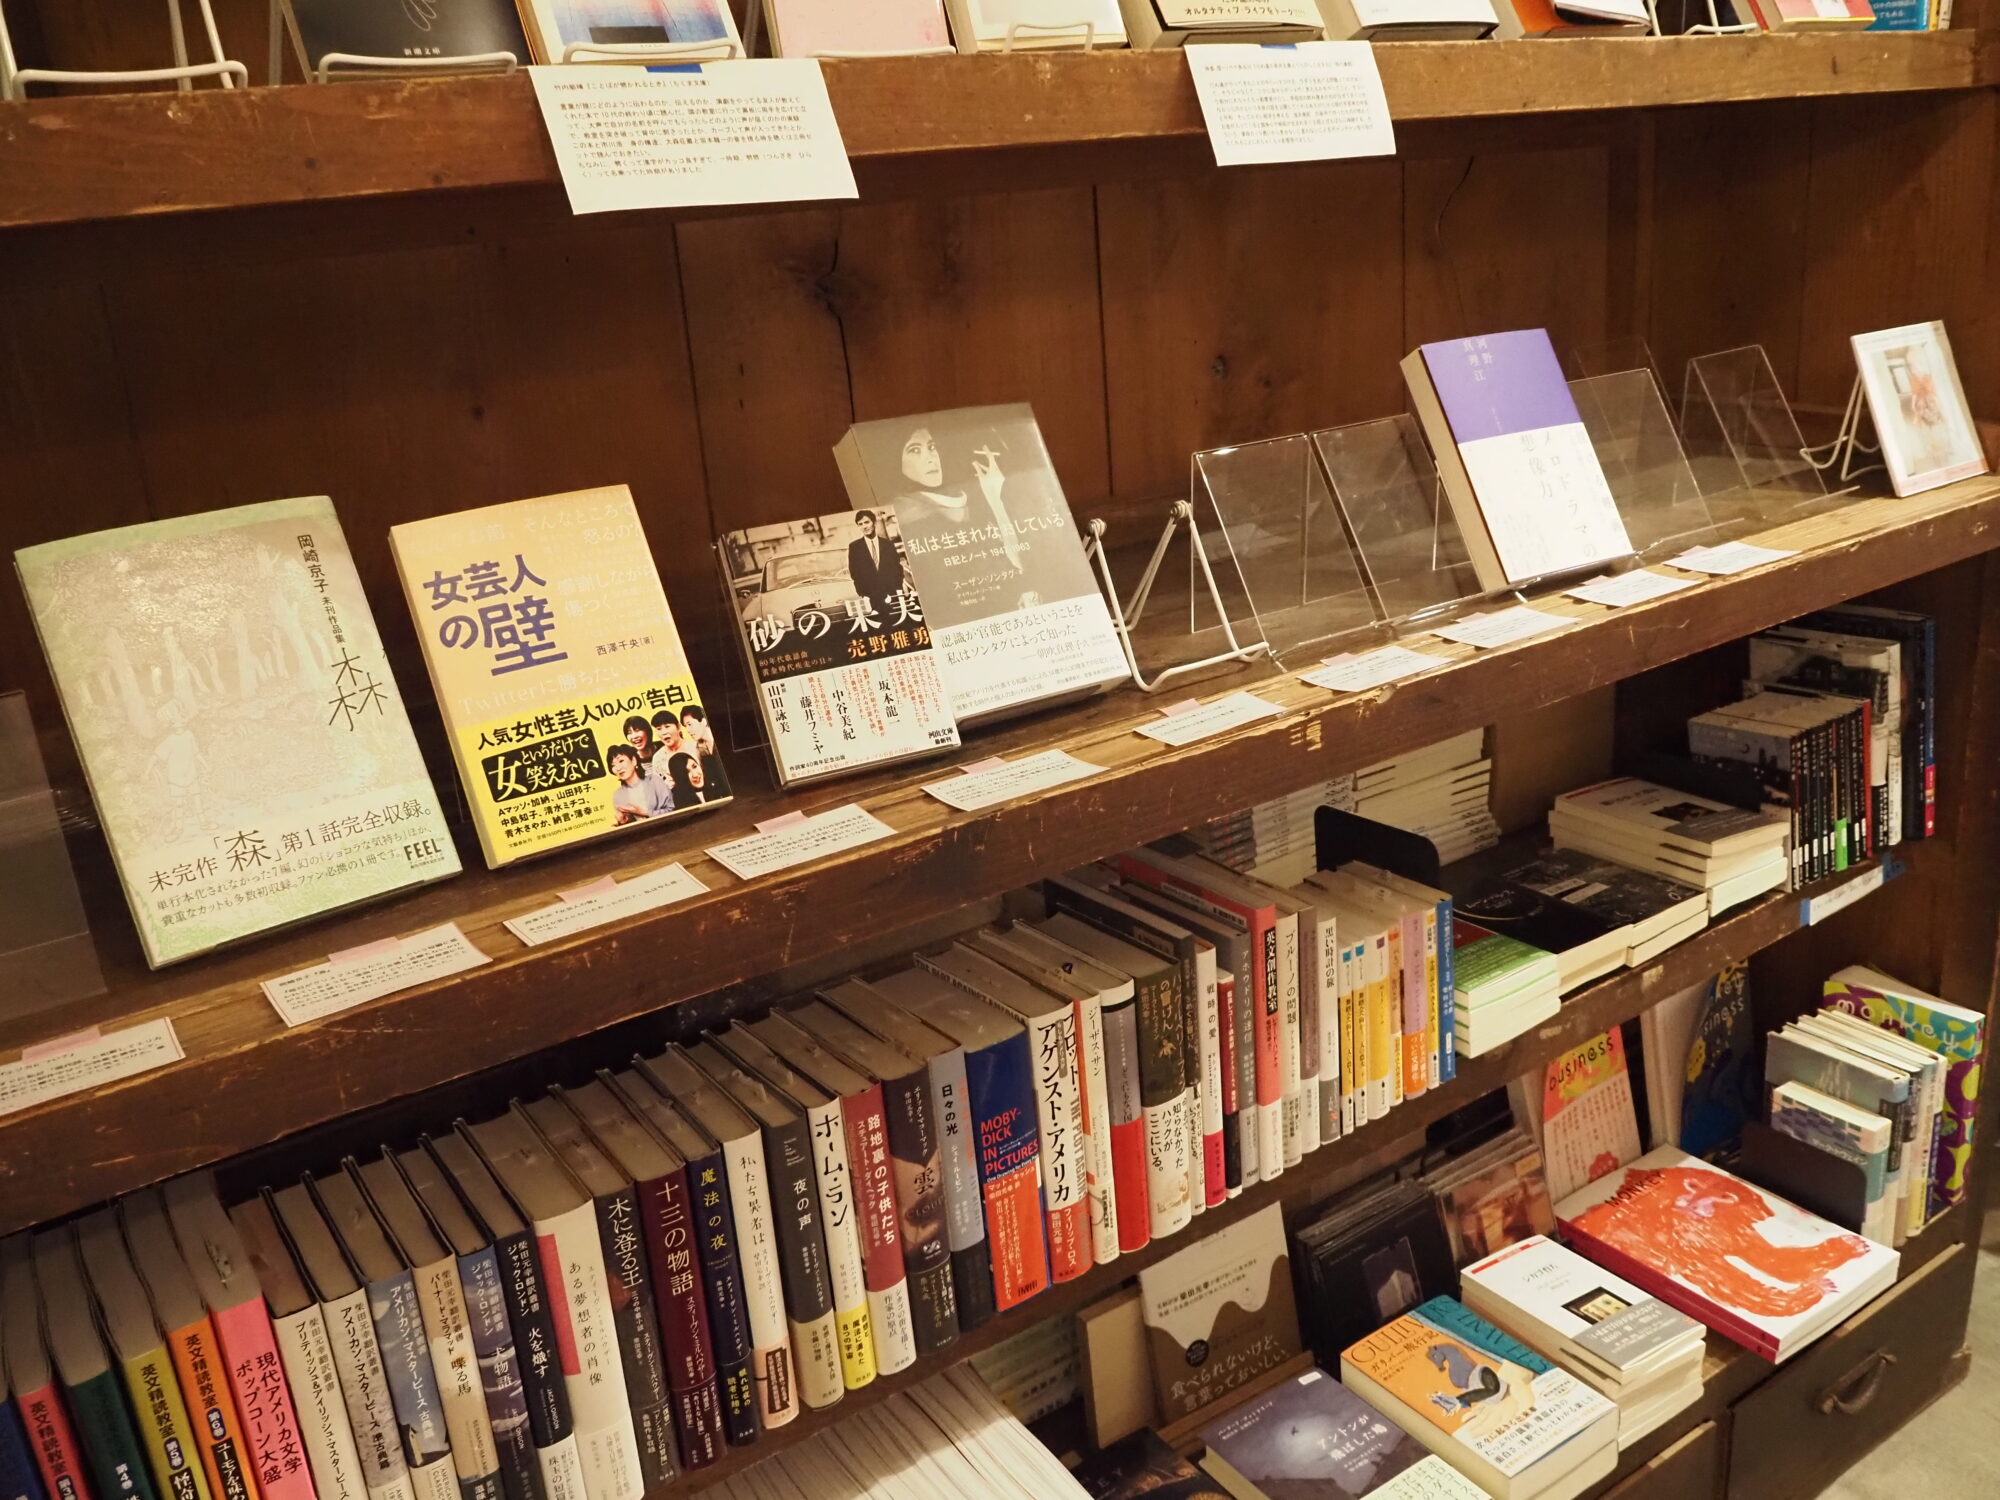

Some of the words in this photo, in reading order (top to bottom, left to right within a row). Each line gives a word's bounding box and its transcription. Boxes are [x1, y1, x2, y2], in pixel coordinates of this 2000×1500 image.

[297, 533, 329, 593] 岡崎京子
[422, 554, 547, 611] 女芸人
[944, 551, 987, 567] 日記とノート
[322, 596, 346, 643] 未刊作品集
[438, 594, 569, 677] の壁
[748, 589, 924, 653] 砂の果実
[848, 626, 931, 659] 売野雅勇
[477, 684, 693, 750] 人気女性芸人10人の「告白」
[768, 686, 791, 734] 山田詠美
[800, 696, 824, 754] 藤井フミヤ
[832, 690, 856, 741] 中谷美紀
[879, 680, 900, 724] 坂本龍一
[520, 734, 590, 765] というだけで
[927, 727, 954, 739] 河出文庫
[487, 755, 529, 801] 女
[526, 758, 599, 789] 笑えない
[404, 838, 442, 861] FEEL
[1265, 931, 1278, 1013] 英文創作教室
[1285, 931, 1298, 1024] ブルーノの問題
[1324, 926, 1335, 988] 黒い時計の旅
[1088, 1005, 1101, 1077] ジーザス・サン
[1836, 998, 1960, 1054] monkey
[941, 1084, 958, 1137] 日々の光
[981, 1109, 1022, 1134] MOBY-
[1037, 1023, 1070, 1204] アゲンスト・アメリカ
[1069, 1094, 1081, 1119] THE
[1162, 1110, 1173, 1152] ハックが
[981, 1128, 1012, 1147] DICK
[983, 1146, 998, 1159] IN
[985, 1140, 1040, 1175] PICTURES
[1072, 1120, 1085, 1155] PLOT
[1150, 1113, 1164, 1173] ここにいる。
[1171, 1103, 1185, 1168] 知らなかった
[814, 1112, 848, 1227] ホーム・ラン
[866, 1113, 895, 1245] 路地裏の子供たち
[914, 1167, 936, 1195] 雲
[996, 1169, 1015, 1180] Drawing
[1604, 1170, 1667, 1208] MONKEY
[700, 1168, 726, 1251] 魔法の夜
[741, 1155, 765, 1245] 私たち異者は
[793, 1179, 813, 1231] 夜の声
[1051, 1210, 1063, 1245] 柴田元幸
[607, 1197, 643, 1289] 木に登る王
[655, 1180, 694, 1297] 十三の物語
[1063, 1207, 1077, 1267] フィリップ・ロス
[470, 1262, 494, 1336] ジャック・ロンドン
[507, 1244, 530, 1318] ジャック・ロンドン
[429, 1275, 456, 1356] バーナード・マラマッド
[568, 1261, 603, 1386] ある夢想者の肖像
[686, 1296, 705, 1380] スティーヴン・ミルハウザー
[842, 1323, 854, 1360] 8つの宇宙
[852, 1318, 866, 1366] 魔法に満ちた
[389, 1286, 428, 1409] アメリカン・マスターピース
[492, 1347, 513, 1391] 犬物語
[528, 1327, 549, 1379] 火を熾す
[1170, 1334, 1279, 1400] 食べられないけど、
[185, 1333, 219, 1410] 英文精読教室
[206, 1409, 226, 1439] 第6巻
[341, 1305, 381, 1437] アメリカン・マスターピース
[370, 1432, 391, 1470] 準古典篇
[450, 1357, 472, 1397] 喋る馬
[28, 1401, 68, 1475] 英文精読教室
[140, 1363, 176, 1439] 英文精読教室
[164, 1439, 185, 1469] 第5巻
[235, 1359, 282, 1486] ポップコーン大盛
[255, 1350, 303, 1475] 現代アメリカ文学
[549, 1403, 560, 1430] LONDON
